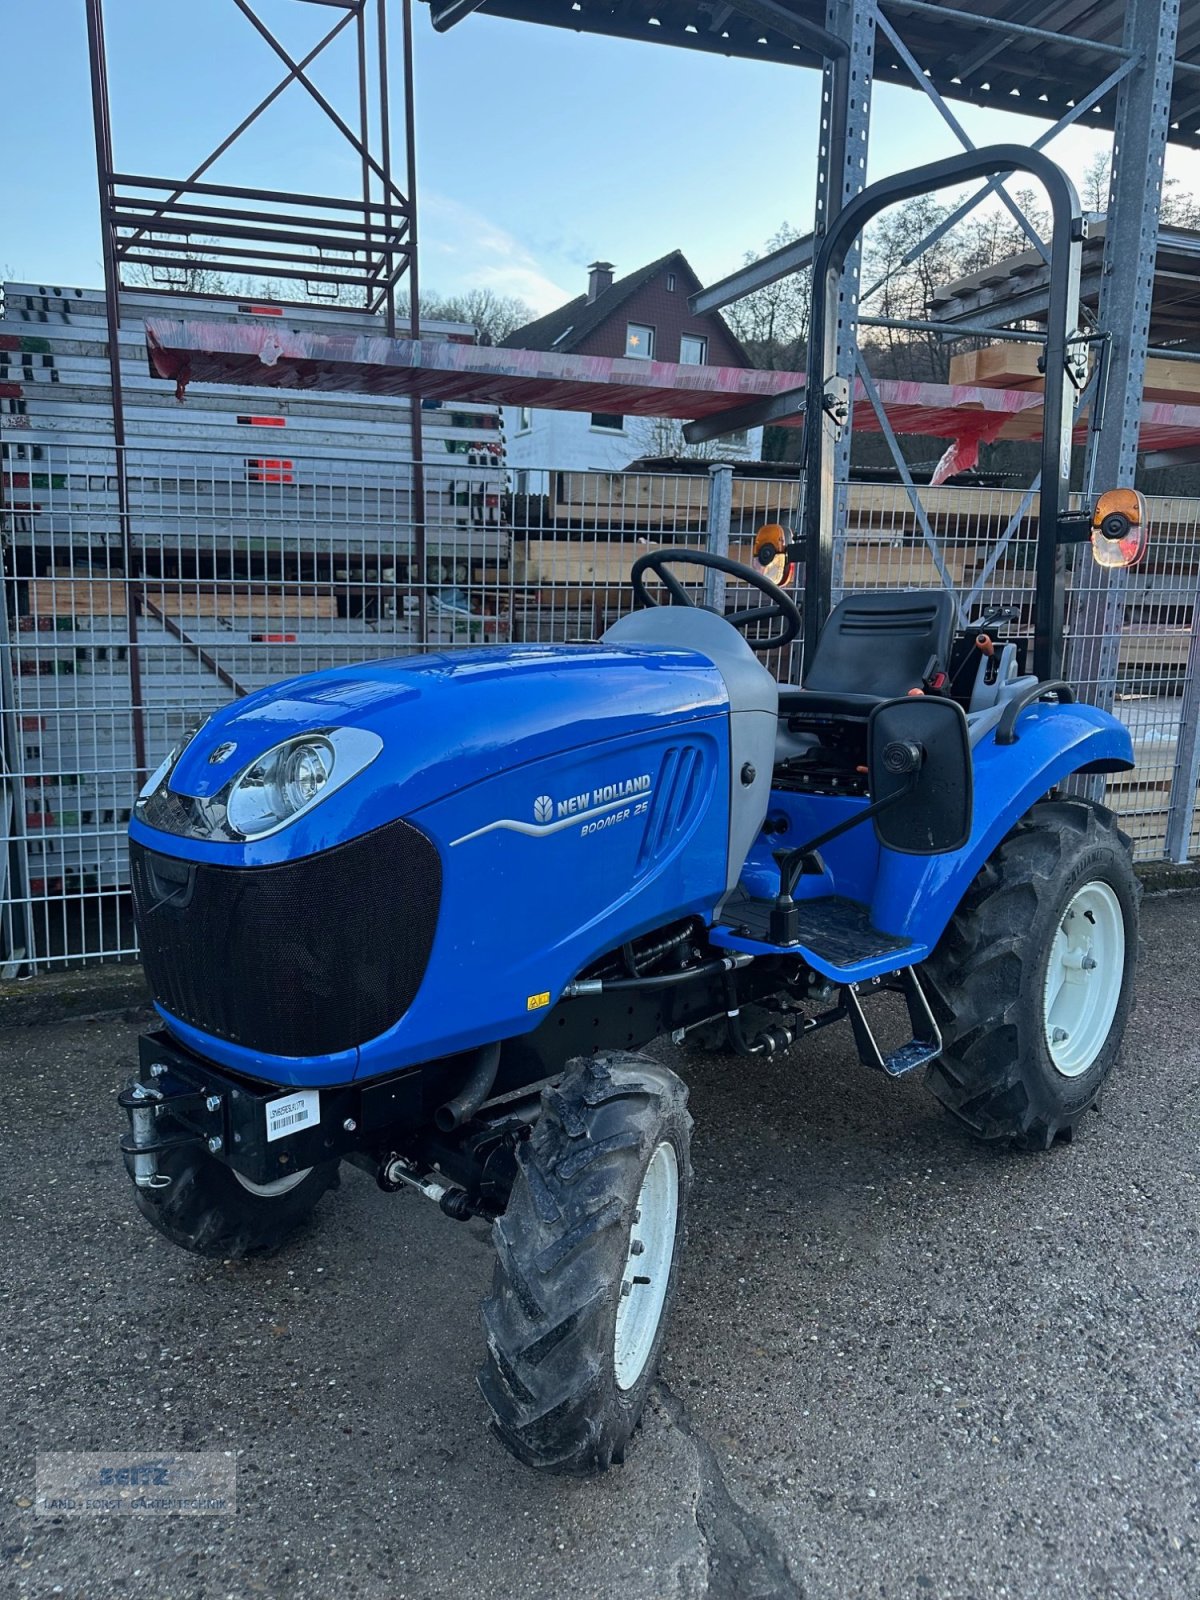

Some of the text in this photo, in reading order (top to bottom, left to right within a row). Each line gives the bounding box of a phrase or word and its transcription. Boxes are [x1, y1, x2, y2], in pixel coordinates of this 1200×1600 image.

[558, 774, 651, 817] NEW HOLLAND
[582, 801, 649, 837] BOOMER 25
